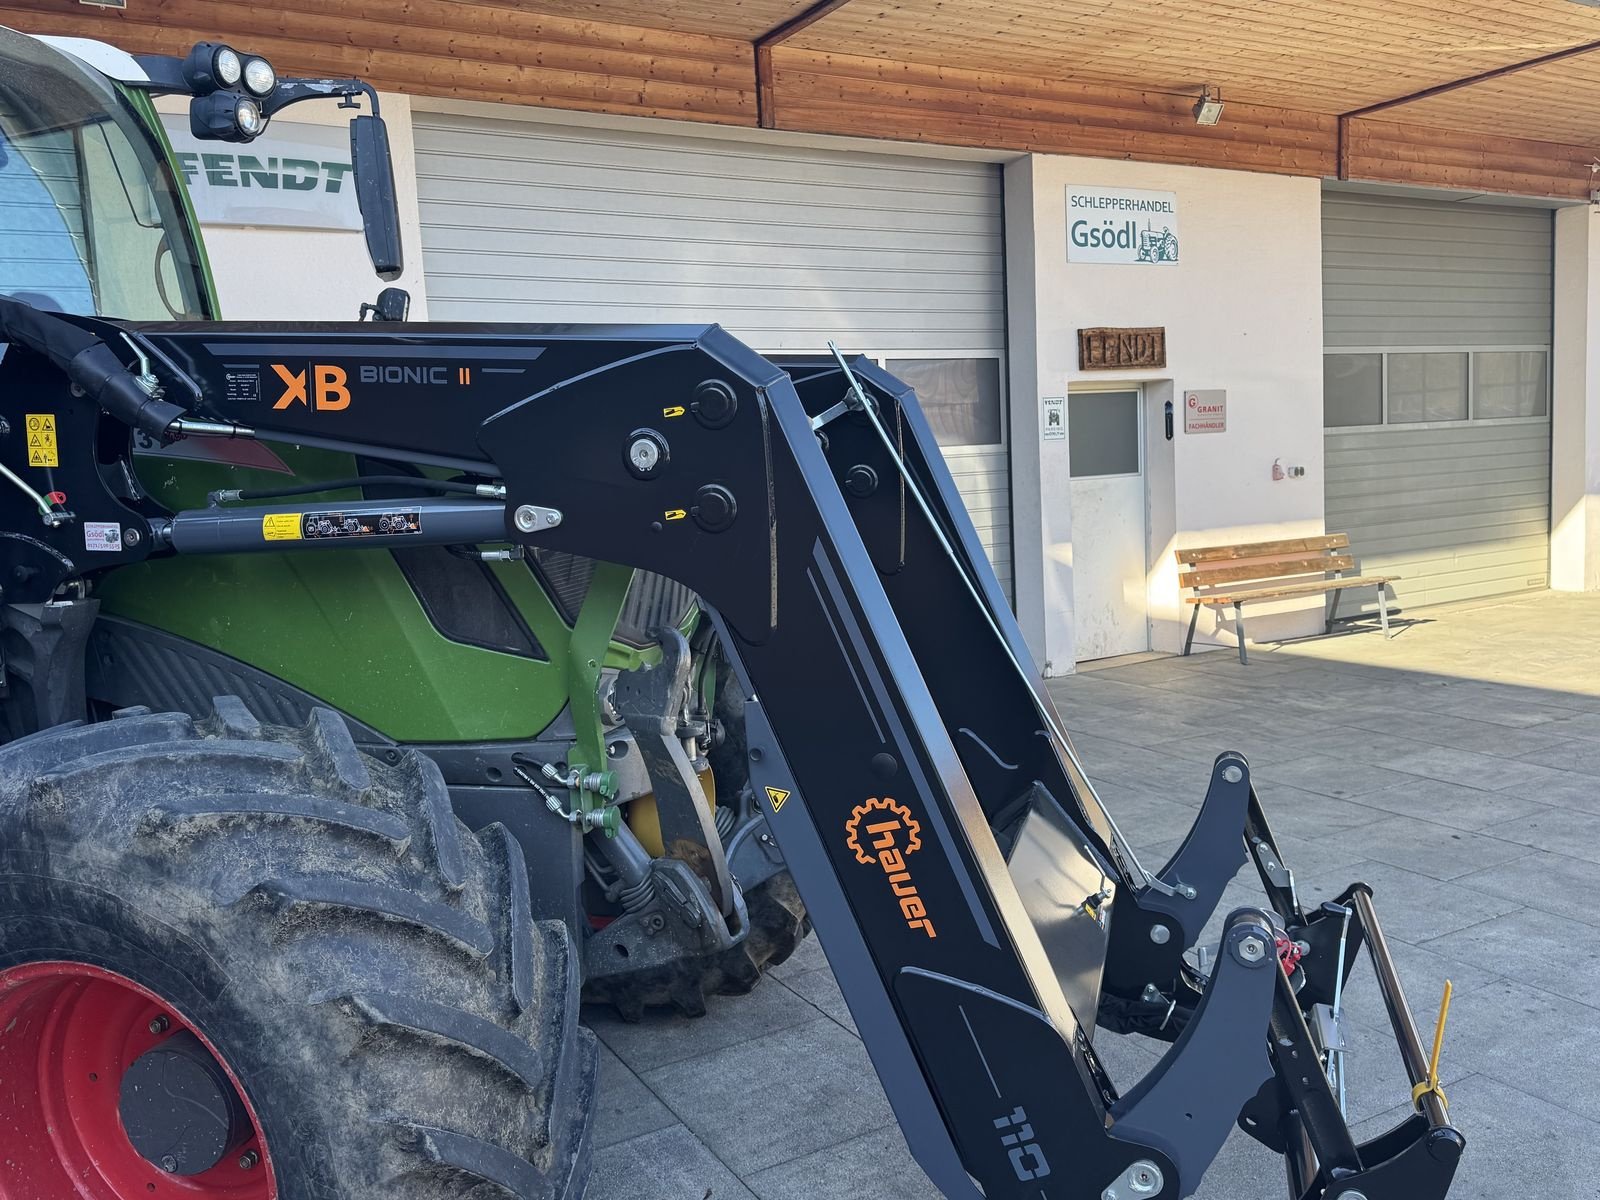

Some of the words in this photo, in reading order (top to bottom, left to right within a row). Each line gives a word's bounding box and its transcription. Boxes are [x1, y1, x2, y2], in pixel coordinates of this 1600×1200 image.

[175, 152, 352, 194] FENDT
[1070, 195, 1175, 213] SCHLEPPERHANDEL
[1071, 219, 1137, 249] Gsödl
[359, 365, 448, 385] BIONIC
[1197, 405, 1223, 413] GRANIT
[1188, 421, 1224, 430] FACHHÄNDLER
[866, 820, 937, 938] hauer
[993, 1105, 1051, 1181] 110
